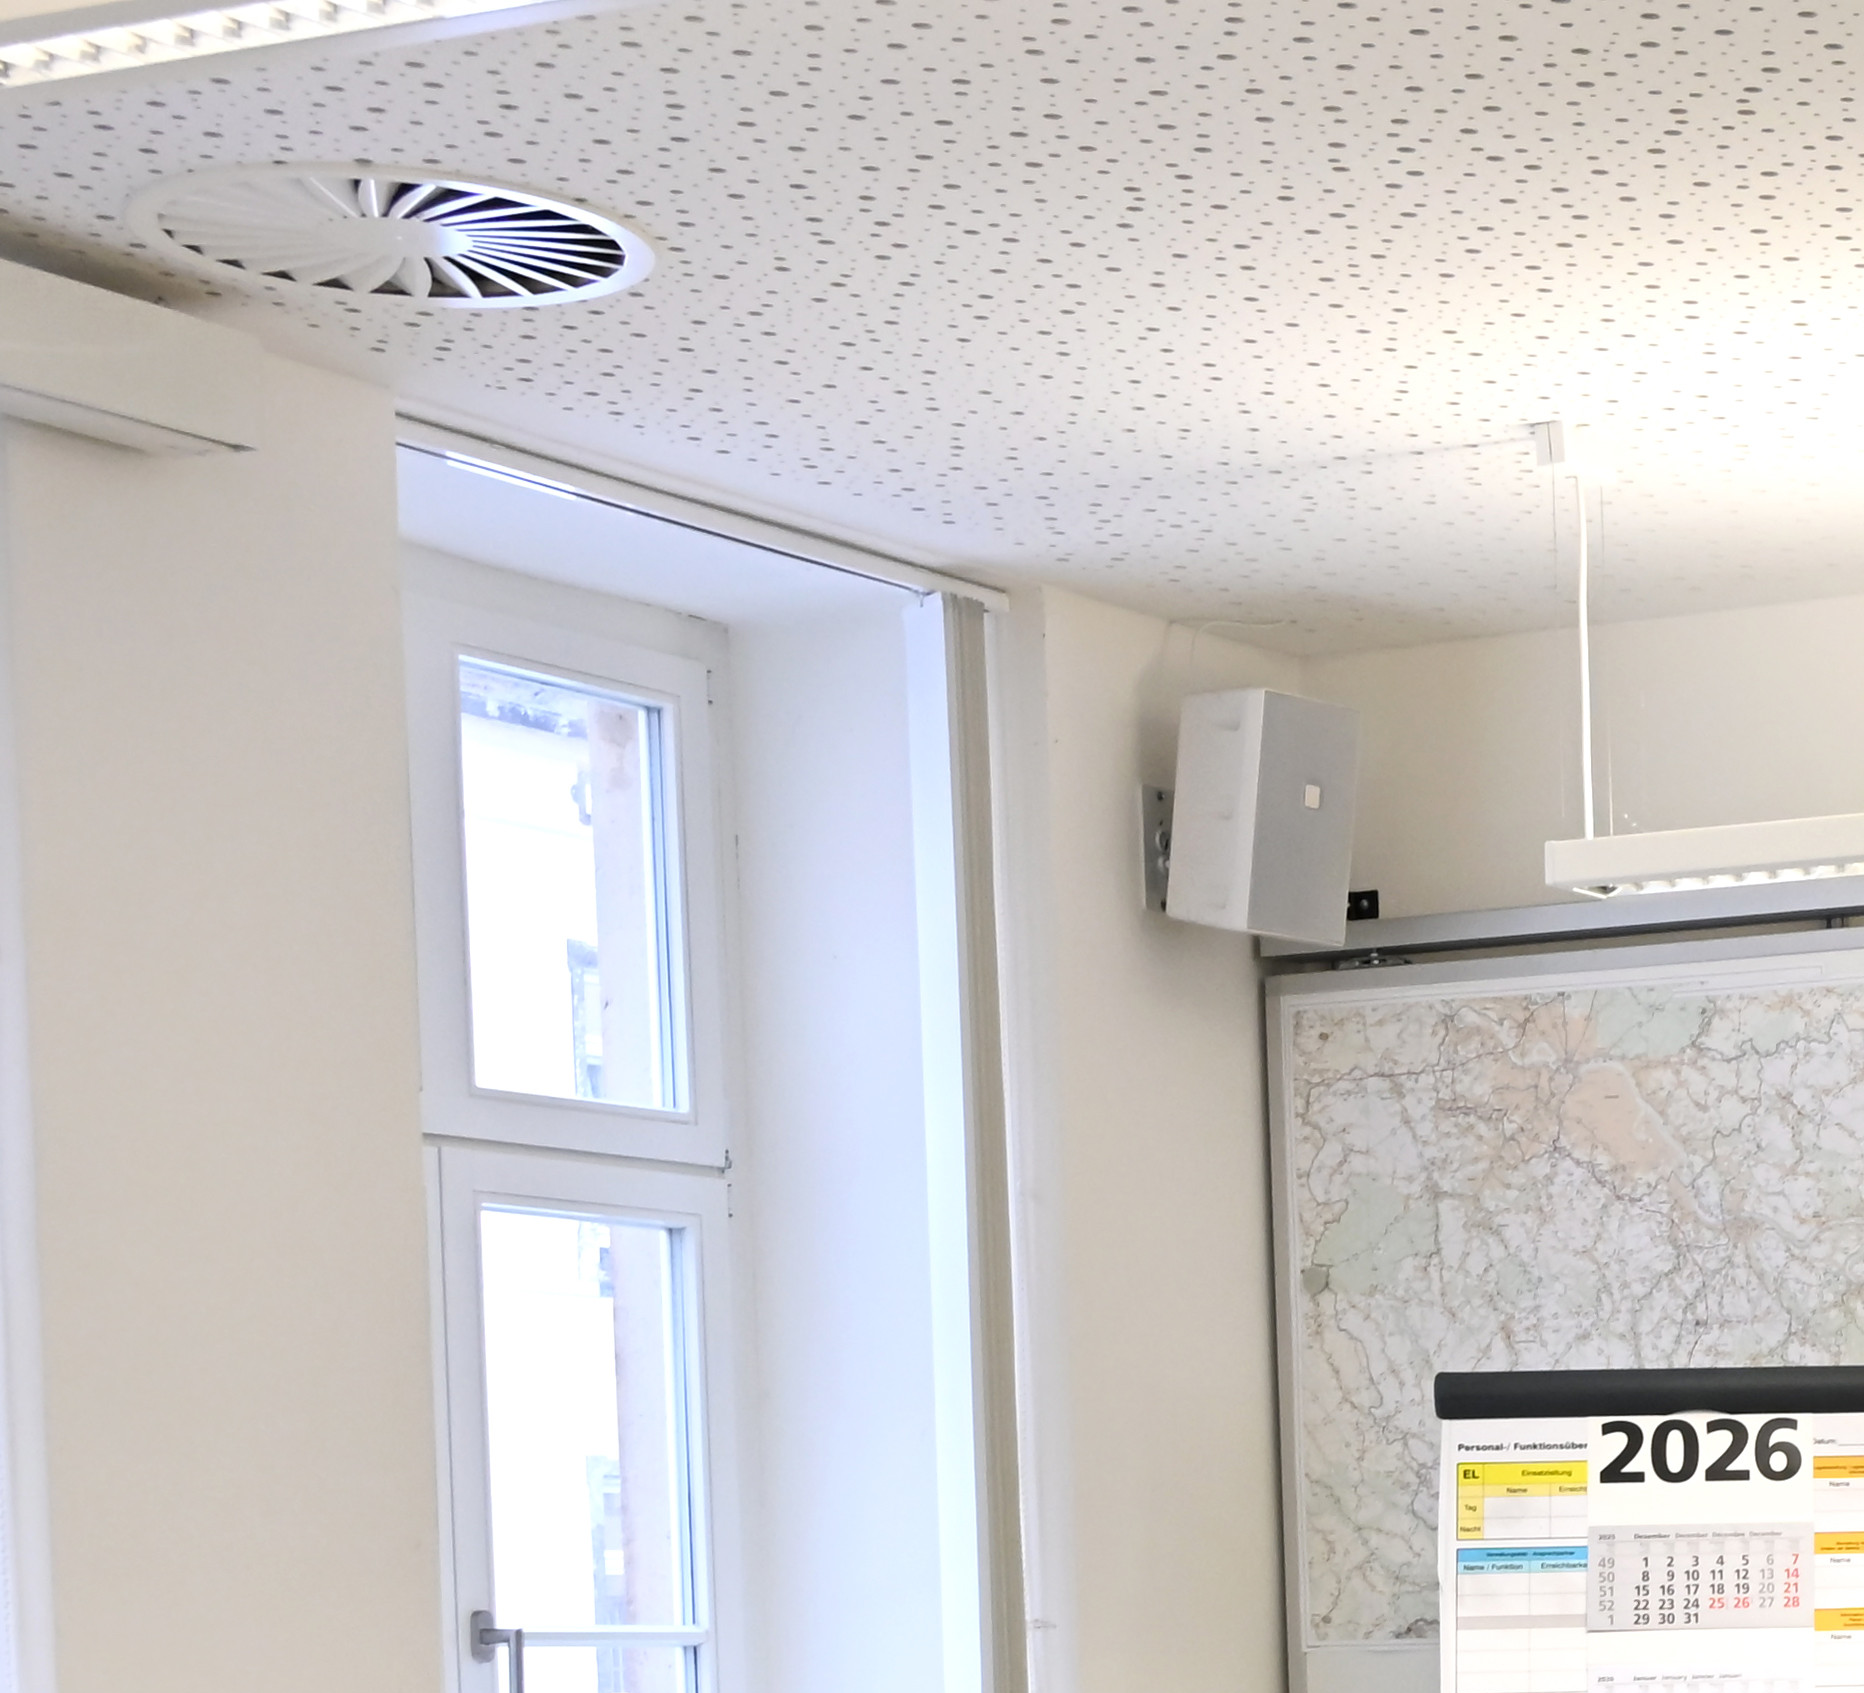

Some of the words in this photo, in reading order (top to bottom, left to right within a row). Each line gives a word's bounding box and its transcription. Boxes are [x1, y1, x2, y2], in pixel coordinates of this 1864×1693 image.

[1599, 1418, 1802, 1484] 2026
[1463, 1469, 1480, 1479] EL
[1598, 1571, 1616, 1584] 50
[1641, 1570, 1650, 1583] 8
[1666, 1569, 1675, 1582] 9
[1684, 1569, 1700, 1582] 10
[1709, 1568, 1724, 1581] 11
[1734, 1568, 1750, 1581] 12
[1759, 1567, 1775, 1581] 13
[1784, 1567, 1800, 1580] 14
